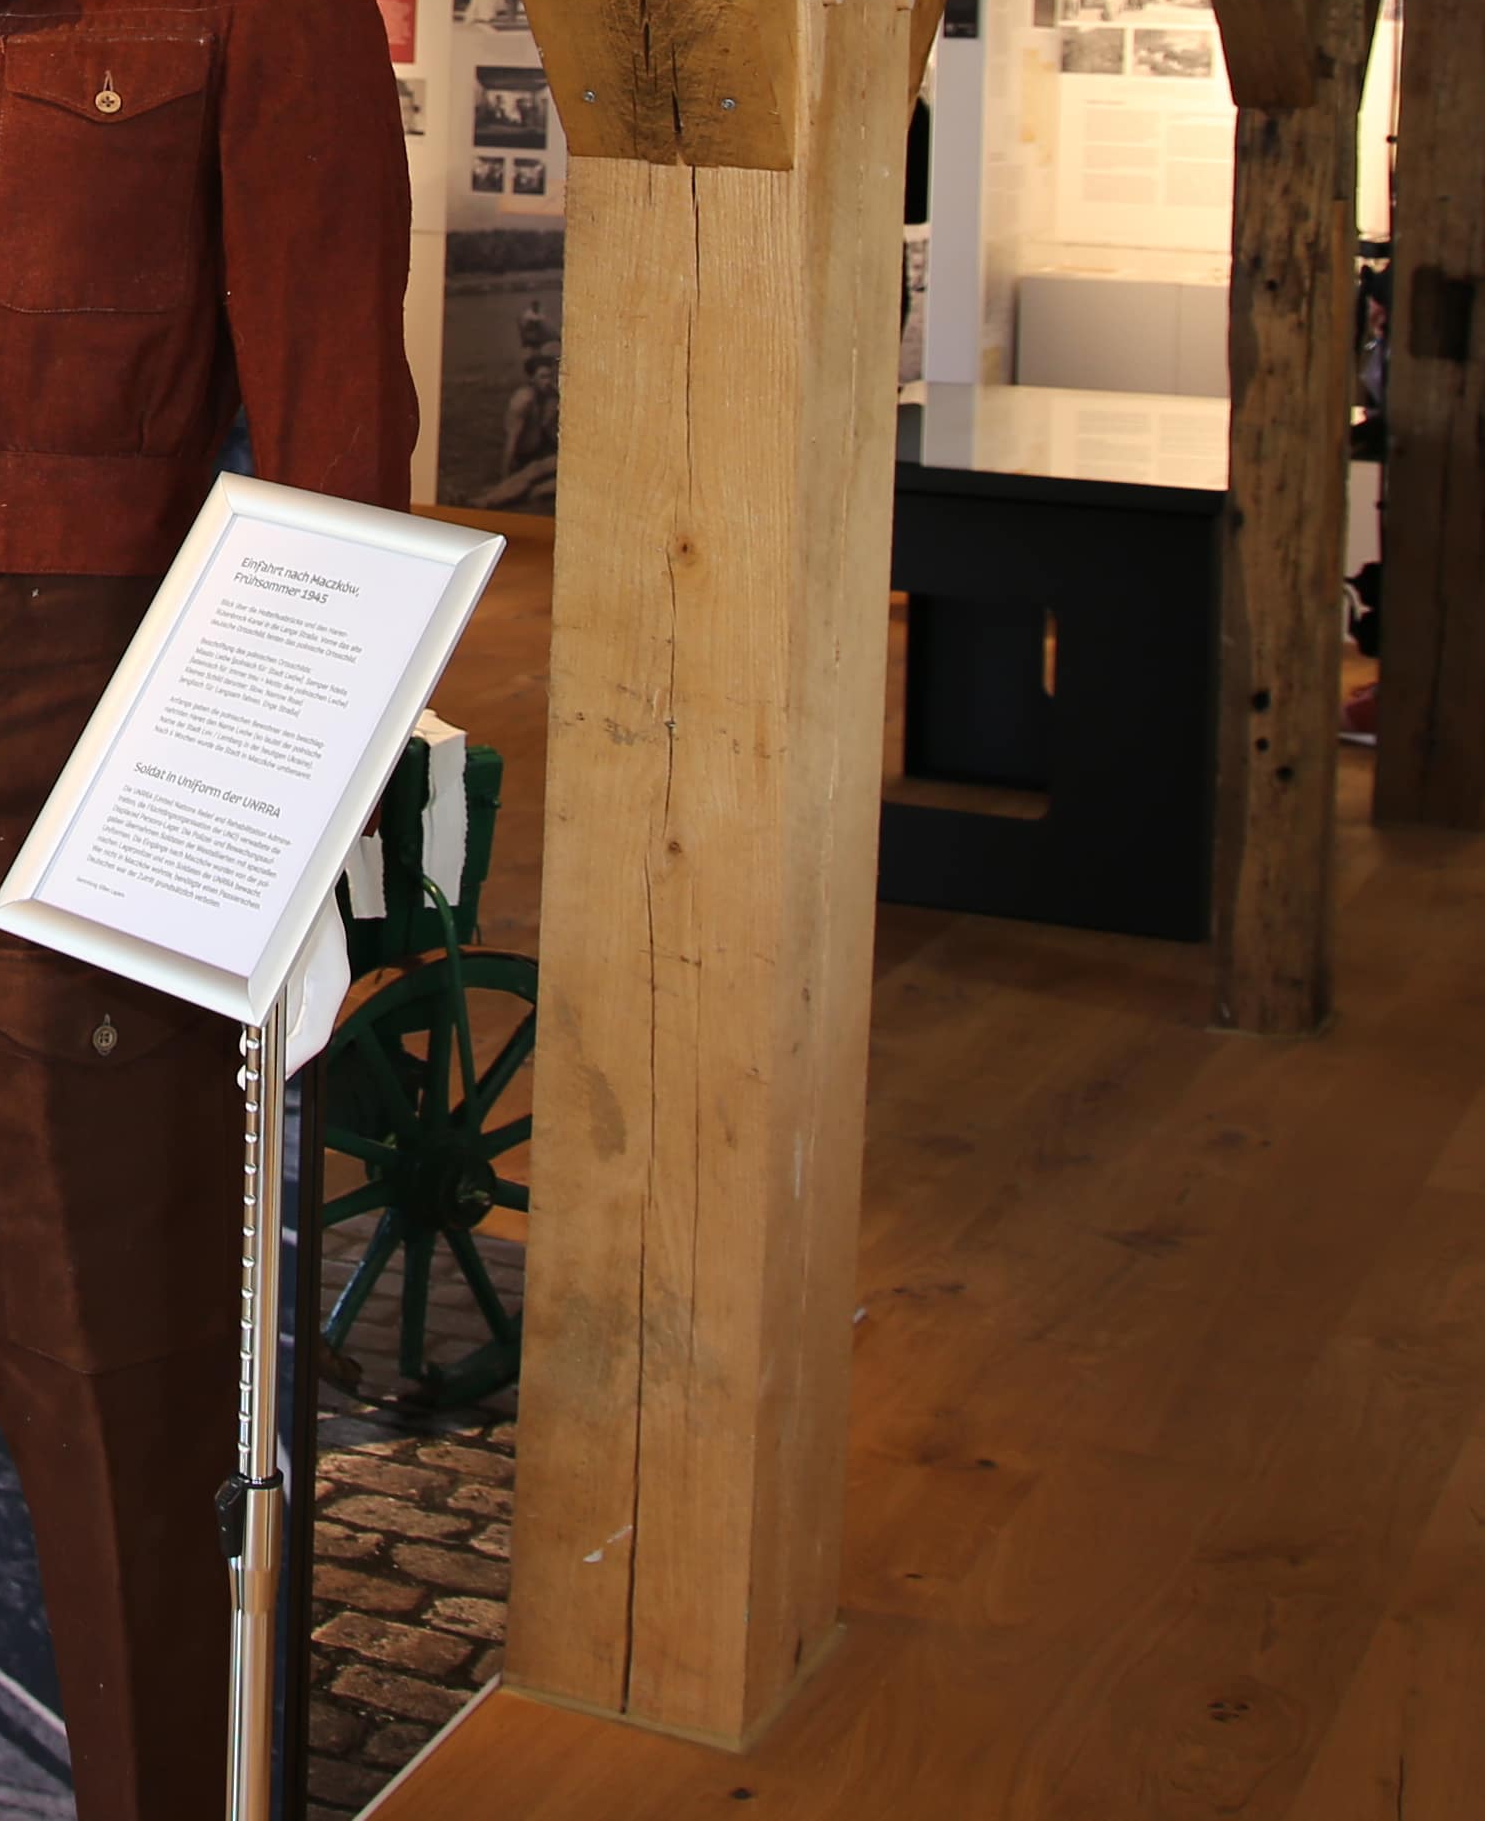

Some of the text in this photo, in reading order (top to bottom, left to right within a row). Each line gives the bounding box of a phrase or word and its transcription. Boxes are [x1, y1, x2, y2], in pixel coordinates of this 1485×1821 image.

[241, 557, 284, 576] Einfahrt
[284, 569, 309, 582] nach
[233, 572, 328, 603] Frühsommer 1945
[134, 762, 280, 818] Soldat in Uniform der UNRRA
